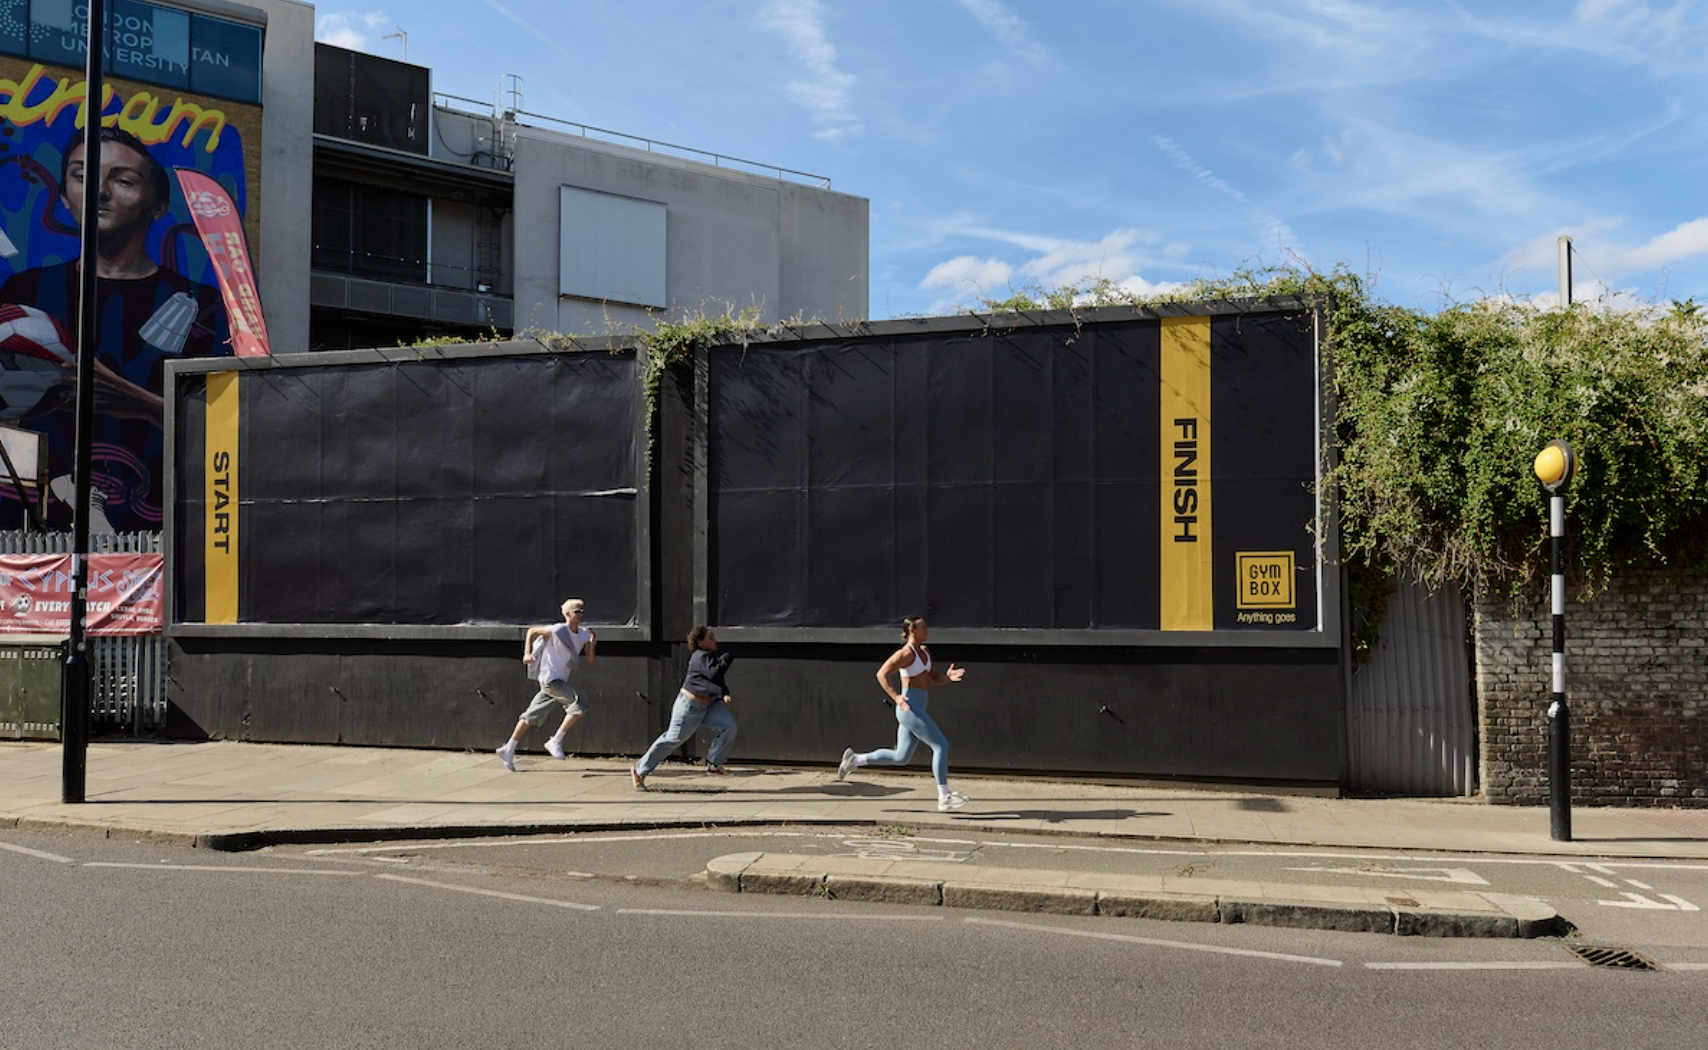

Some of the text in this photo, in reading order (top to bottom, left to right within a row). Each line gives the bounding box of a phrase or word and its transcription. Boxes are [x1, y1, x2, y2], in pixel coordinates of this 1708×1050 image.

[1174, 417, 1197, 543] FINISH
[213, 451, 230, 554] START
[1250, 564, 1281, 579] GYM
[1250, 581, 1281, 596] BOX
[35, 601, 112, 613] EVERY ATCH
[1237, 612, 1296, 624] Anything goes
